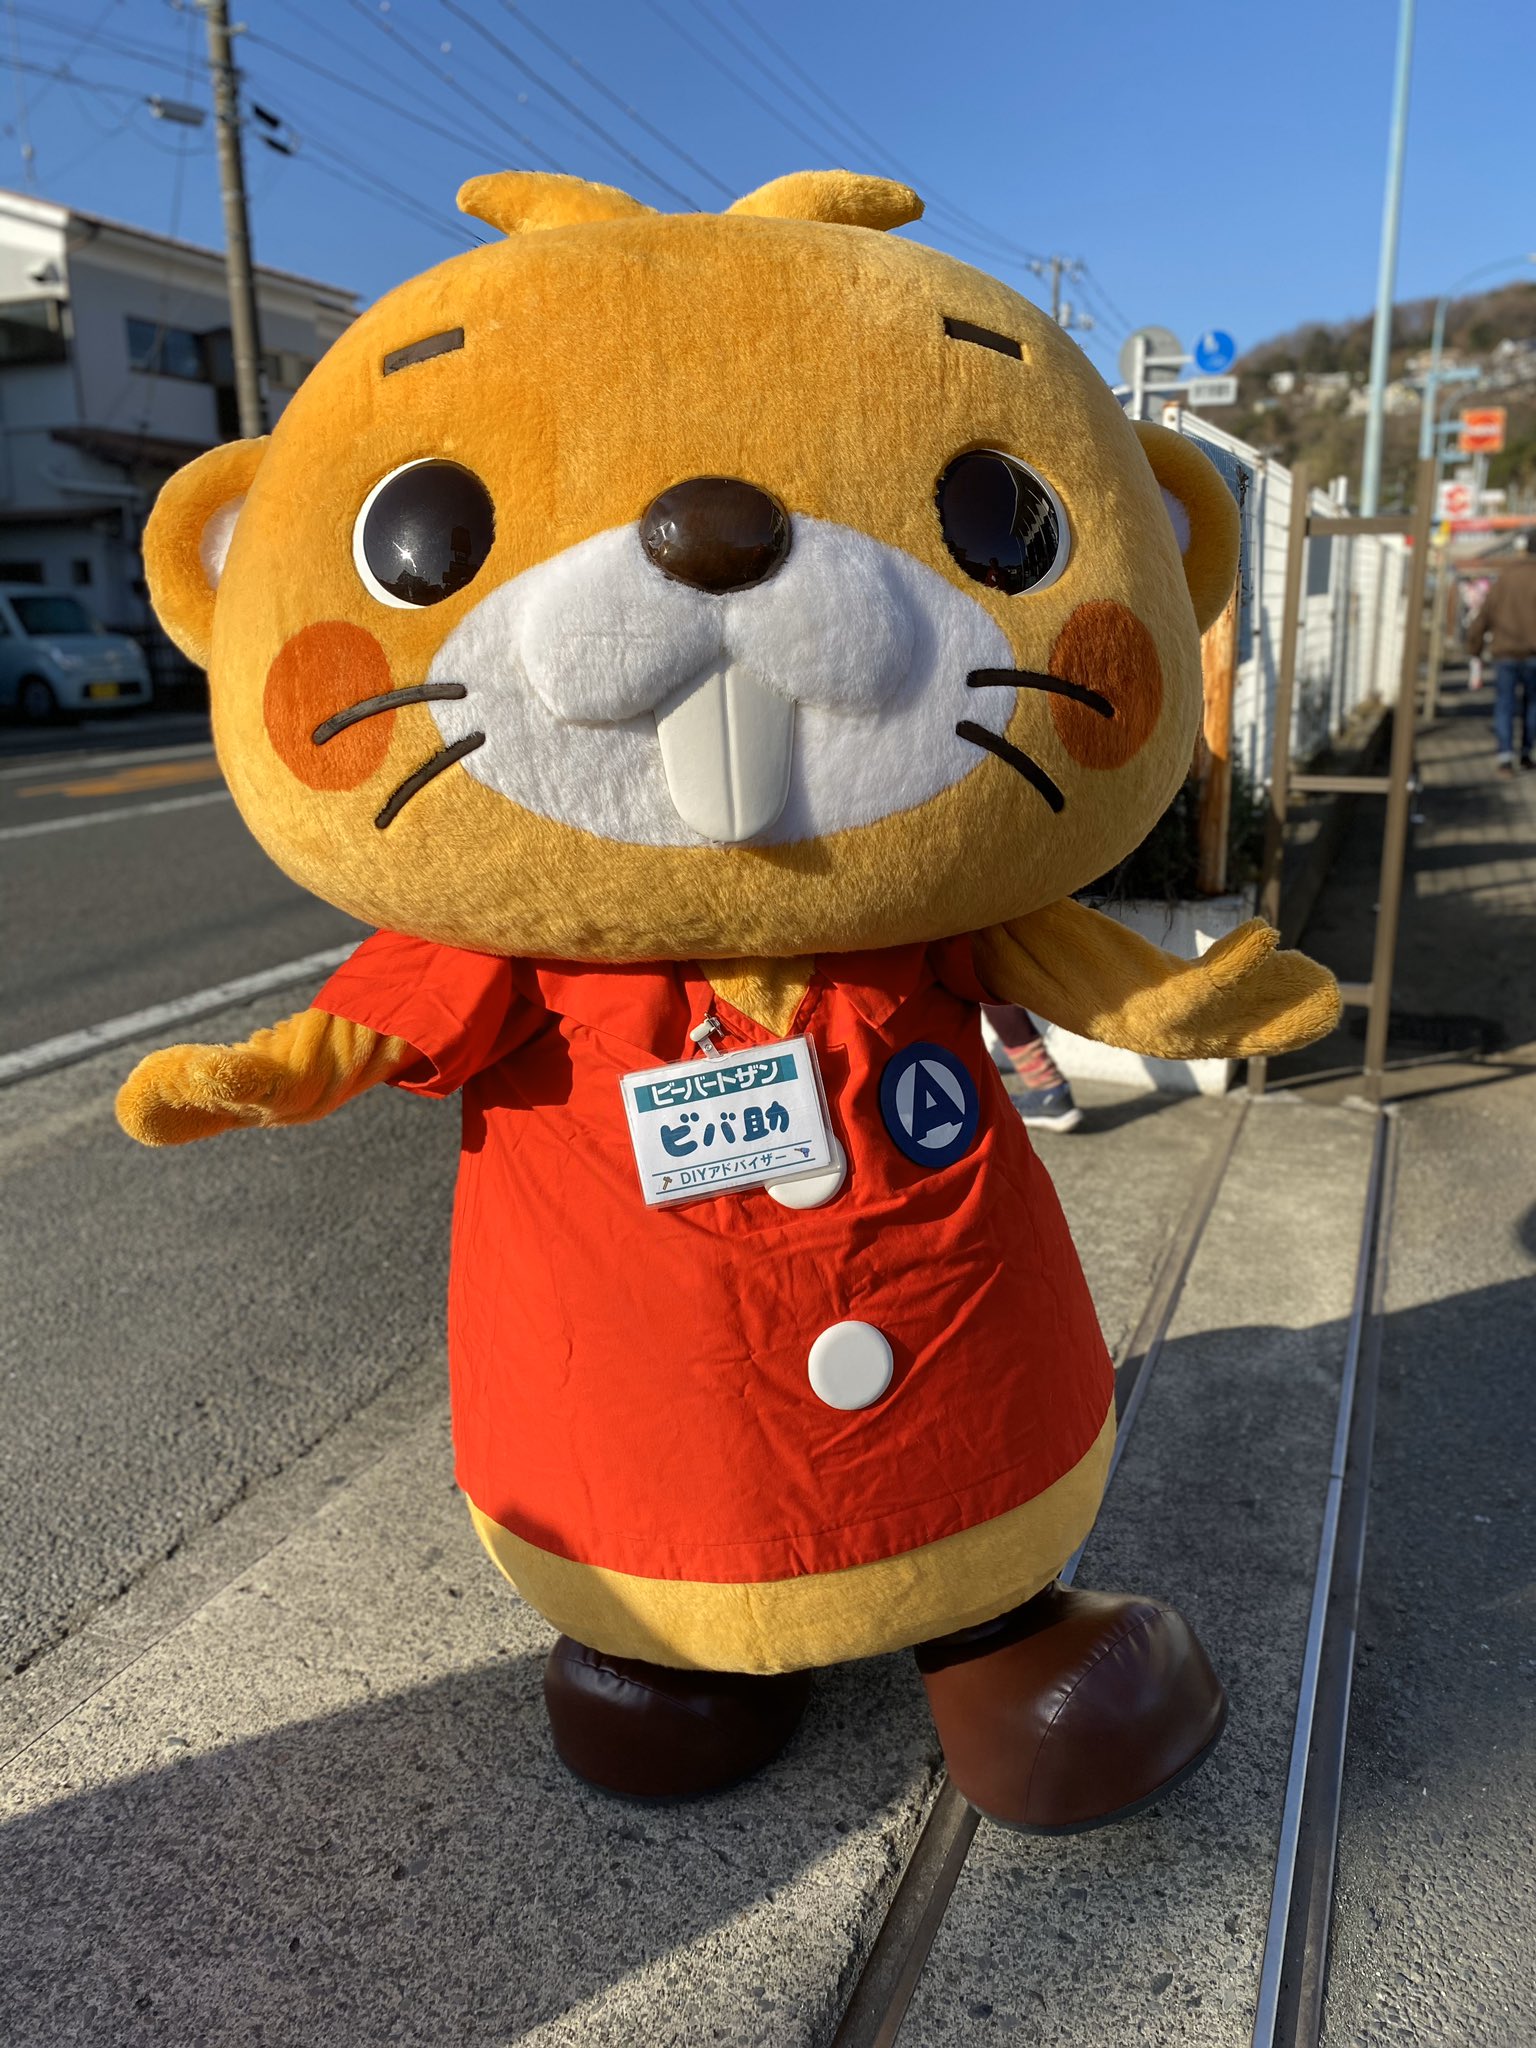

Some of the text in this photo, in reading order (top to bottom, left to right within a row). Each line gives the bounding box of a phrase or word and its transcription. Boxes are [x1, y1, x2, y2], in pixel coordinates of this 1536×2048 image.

[651, 1061, 780, 1107] ビーバートザン
[660, 1100, 790, 1157] ビバ助
[680, 1153, 787, 1186] DIYアドバイザー
